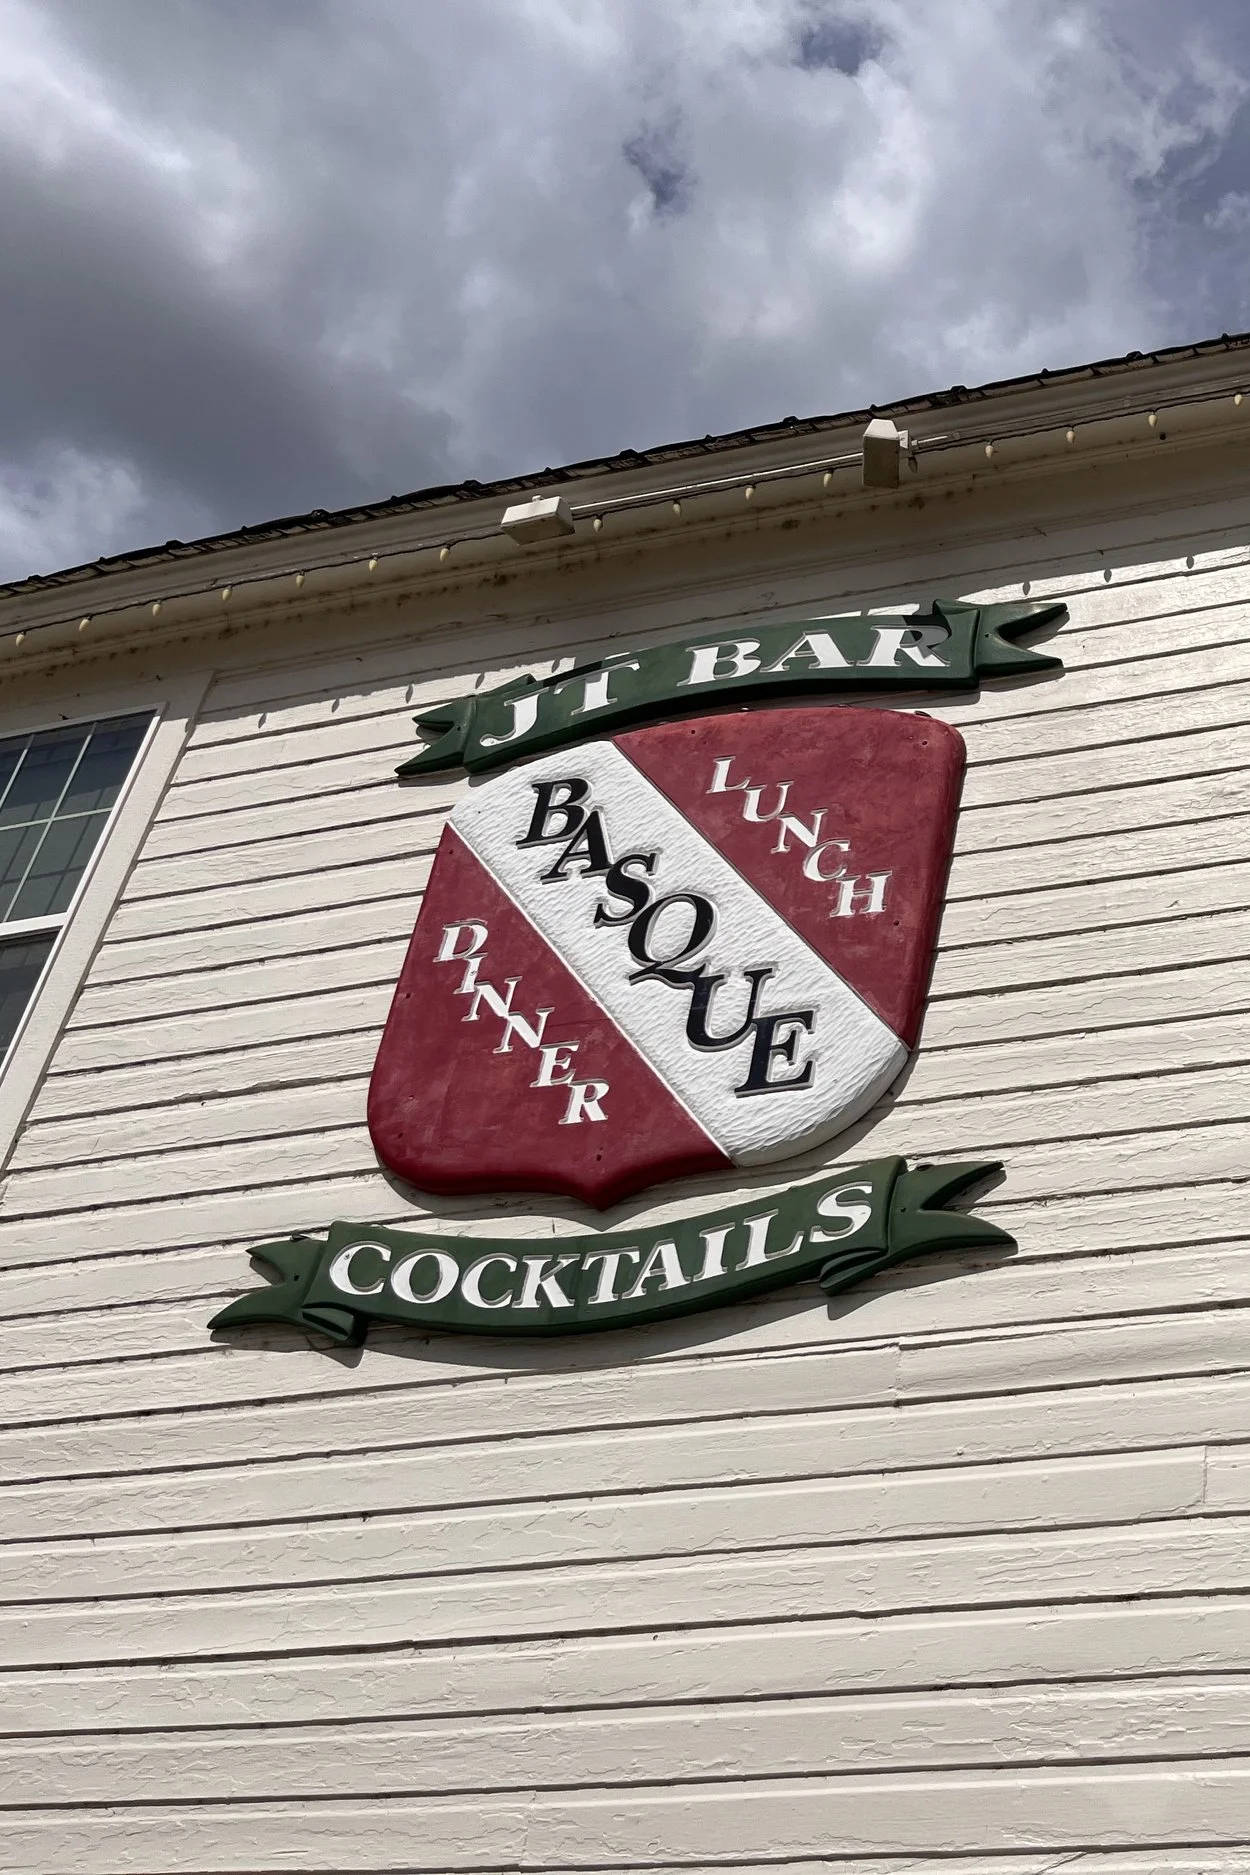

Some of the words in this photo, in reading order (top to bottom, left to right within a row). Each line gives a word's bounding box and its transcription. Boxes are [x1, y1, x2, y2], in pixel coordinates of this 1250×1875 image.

[479, 660, 642, 747] JT
[676, 623, 952, 687] BAR
[707, 756, 892, 919] LUNCH
[516, 777, 817, 1098] BASQUE
[433, 919, 610, 1125] DINNER
[328, 1181, 874, 1309] COCKTAILS
